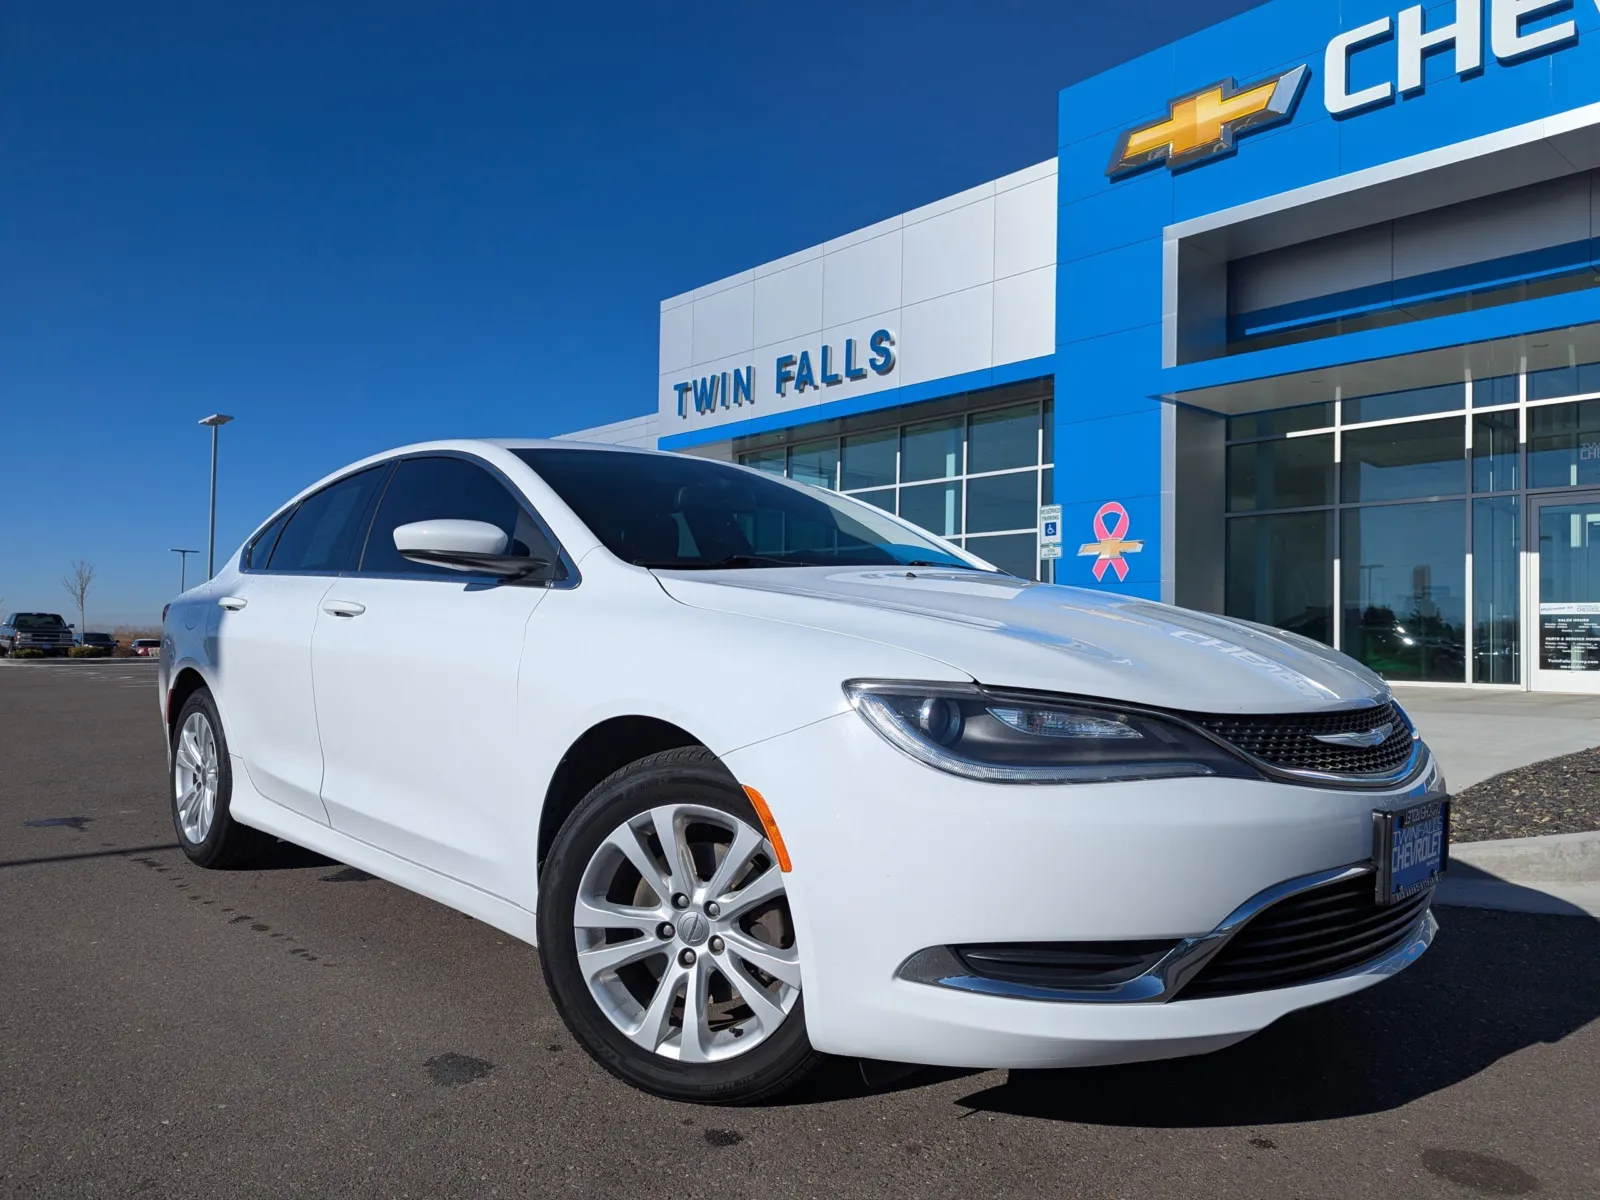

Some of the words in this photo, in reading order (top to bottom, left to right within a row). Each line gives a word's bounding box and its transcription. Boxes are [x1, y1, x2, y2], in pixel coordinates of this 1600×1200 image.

[1324, 0, 1600, 119] CHE
[674, 365, 756, 419] TWIN
[775, 329, 896, 397] FALLS
[1392, 831, 1443, 873] CHEVROLET
